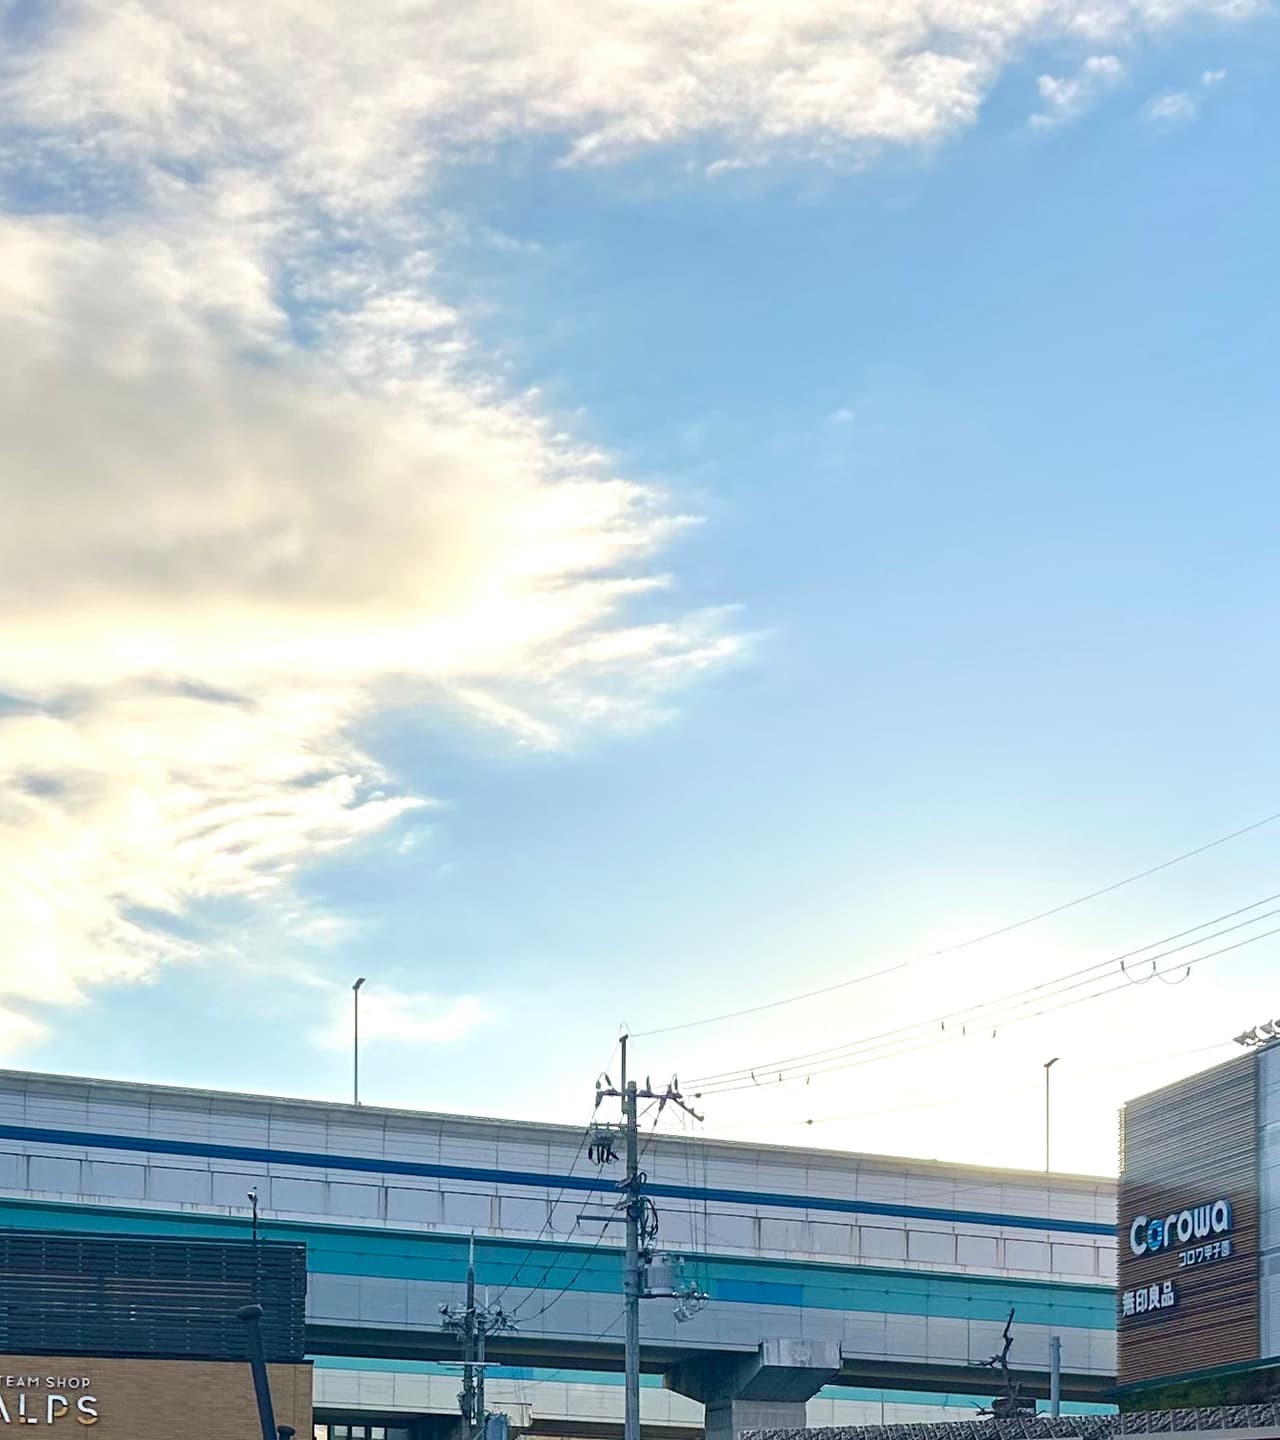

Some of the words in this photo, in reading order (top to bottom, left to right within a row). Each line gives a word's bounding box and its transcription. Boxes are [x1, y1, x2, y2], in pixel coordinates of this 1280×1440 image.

[1129, 1199, 1231, 1256] Corowa
[1178, 1240, 1231, 1267] コロワ甲子園
[1122, 1281, 1175, 1317] 無印良品
[45, 1376, 91, 1389] SHOP
